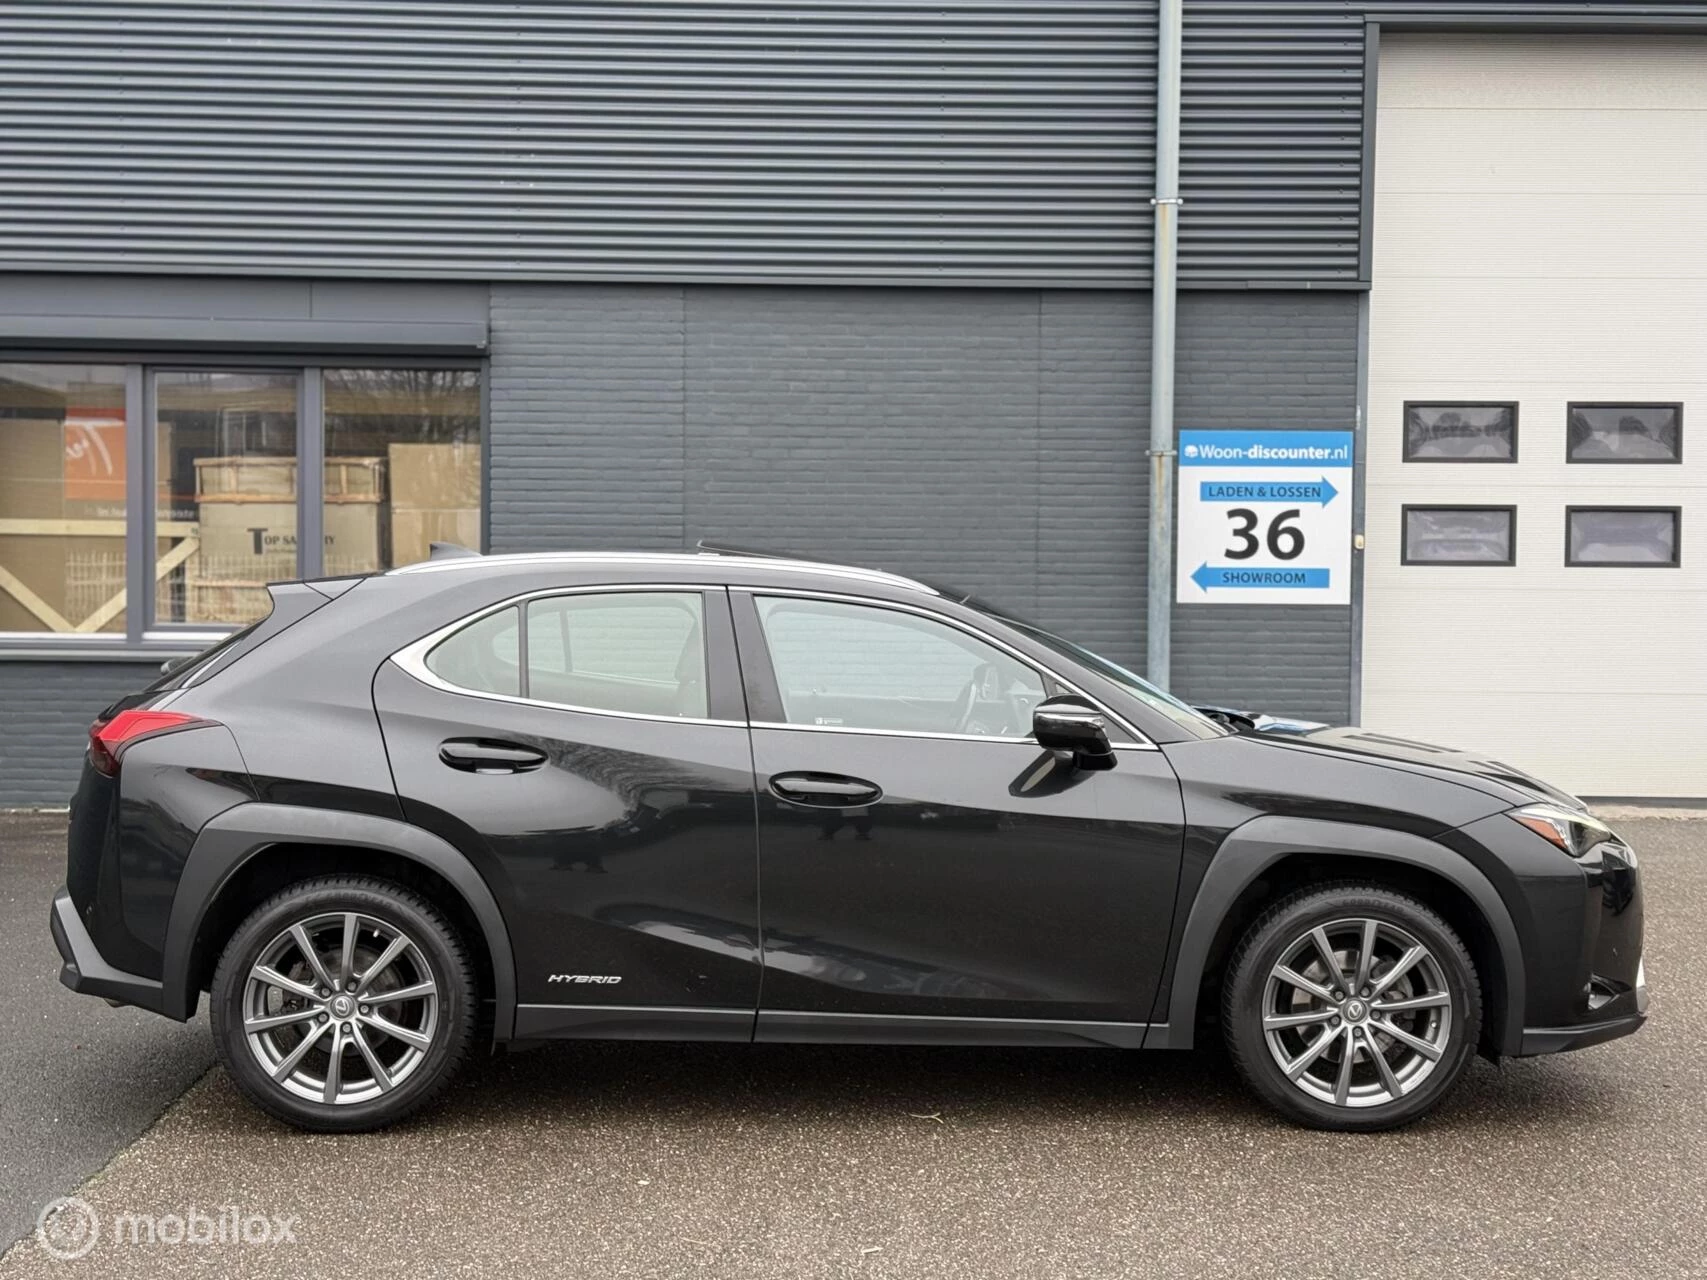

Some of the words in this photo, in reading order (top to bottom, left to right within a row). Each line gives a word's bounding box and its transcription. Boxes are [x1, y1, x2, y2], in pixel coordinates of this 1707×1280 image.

[1199, 444, 1348, 460] Woon-discounter.nl
[1208, 486, 1254, 498] LADEN
[1257, 486, 1267, 498] &
[1270, 486, 1322, 498] LOSSEN
[247, 527, 280, 555] TOP
[1224, 508, 1305, 561] 36
[1222, 571, 1306, 584] SHOWROOM
[547, 974, 623, 984] HYBRID
